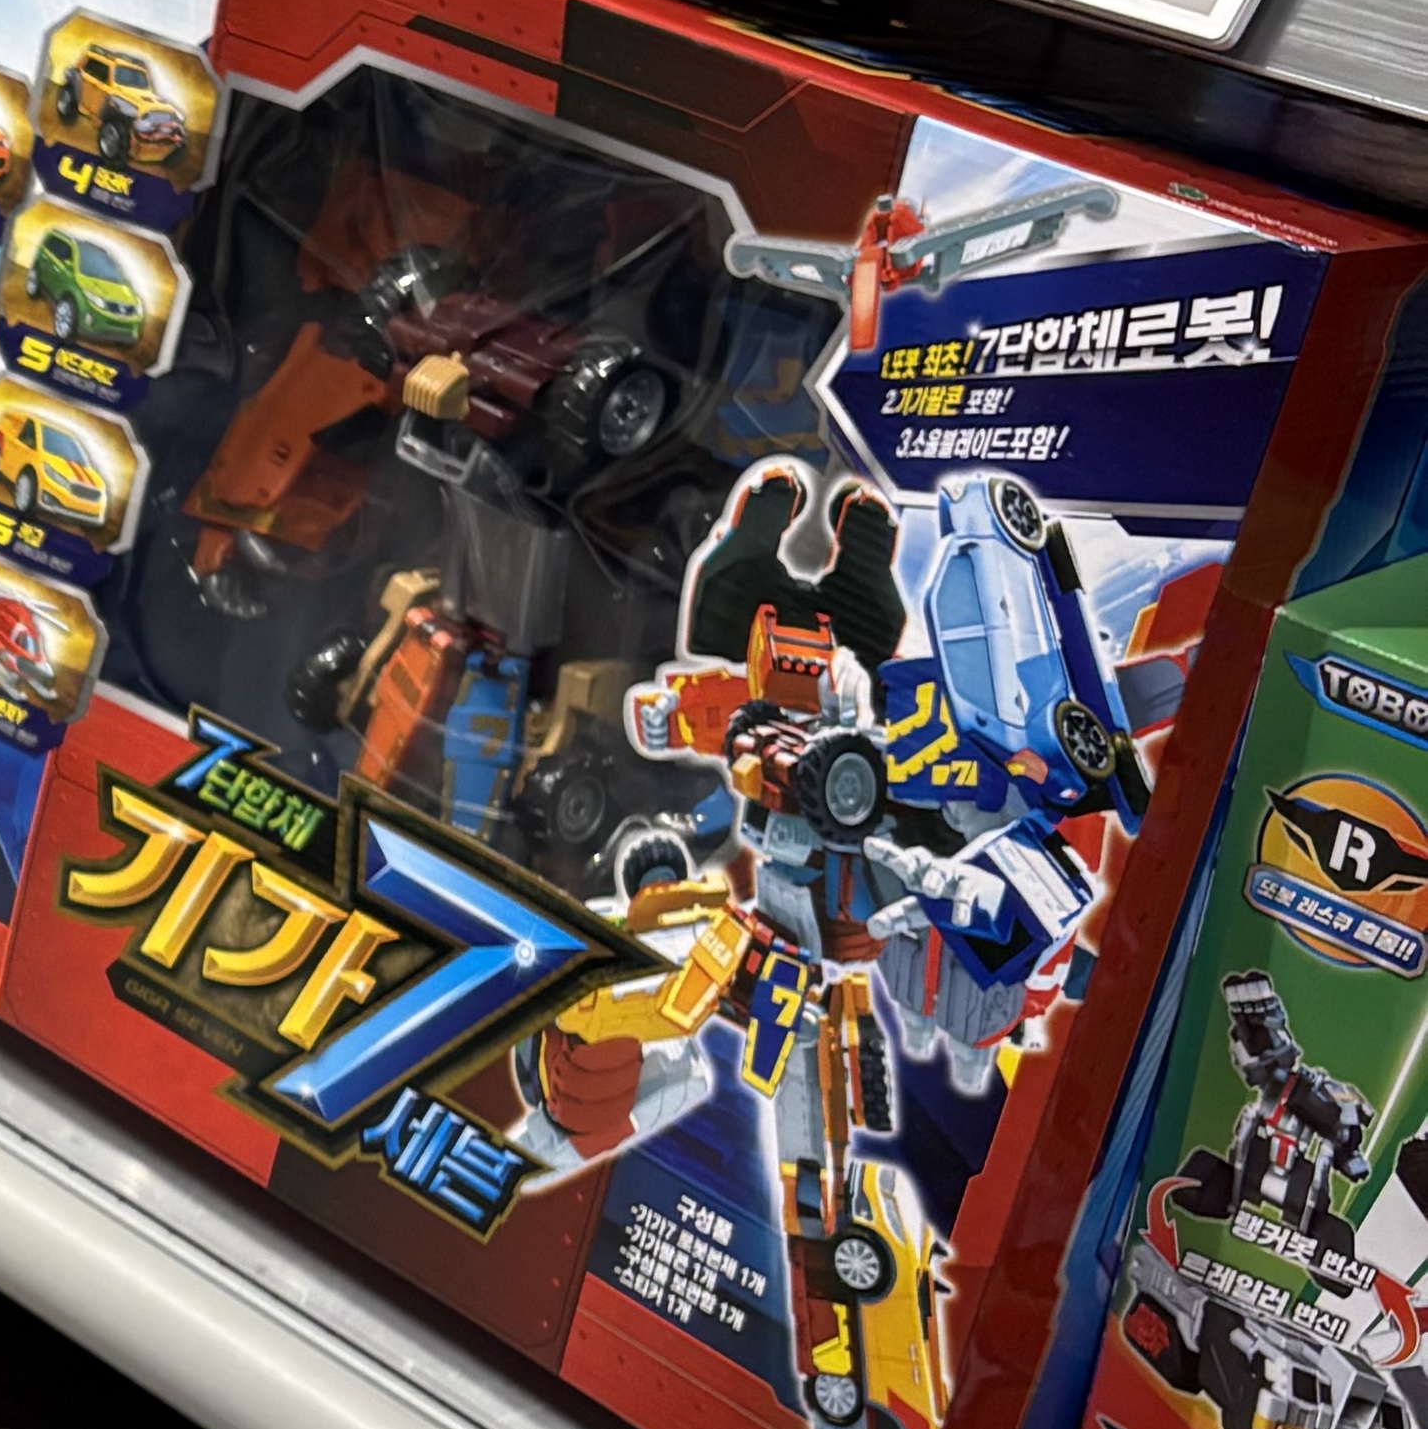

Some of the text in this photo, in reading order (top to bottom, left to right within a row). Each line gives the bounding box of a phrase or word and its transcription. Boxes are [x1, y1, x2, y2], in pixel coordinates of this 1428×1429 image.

[57, 153, 93, 195] 4
[16, 335, 54, 373] 5
[922, 340, 976, 378] 최초!
[975, 285, 1284, 374] 7단합체로봇!
[964, 385, 1016, 417] 포함!
[175, 717, 325, 852] 7단합체
[1257, 877, 1296, 907] 또봇
[1296, 895, 1354, 934] 레스큐
[772, 984, 803, 1027] 7
[363, 1085, 527, 1226] 세트
[1320, 1248, 1377, 1289] 변신!
[1177, 1250, 1351, 1342] 트레일러 변신!
